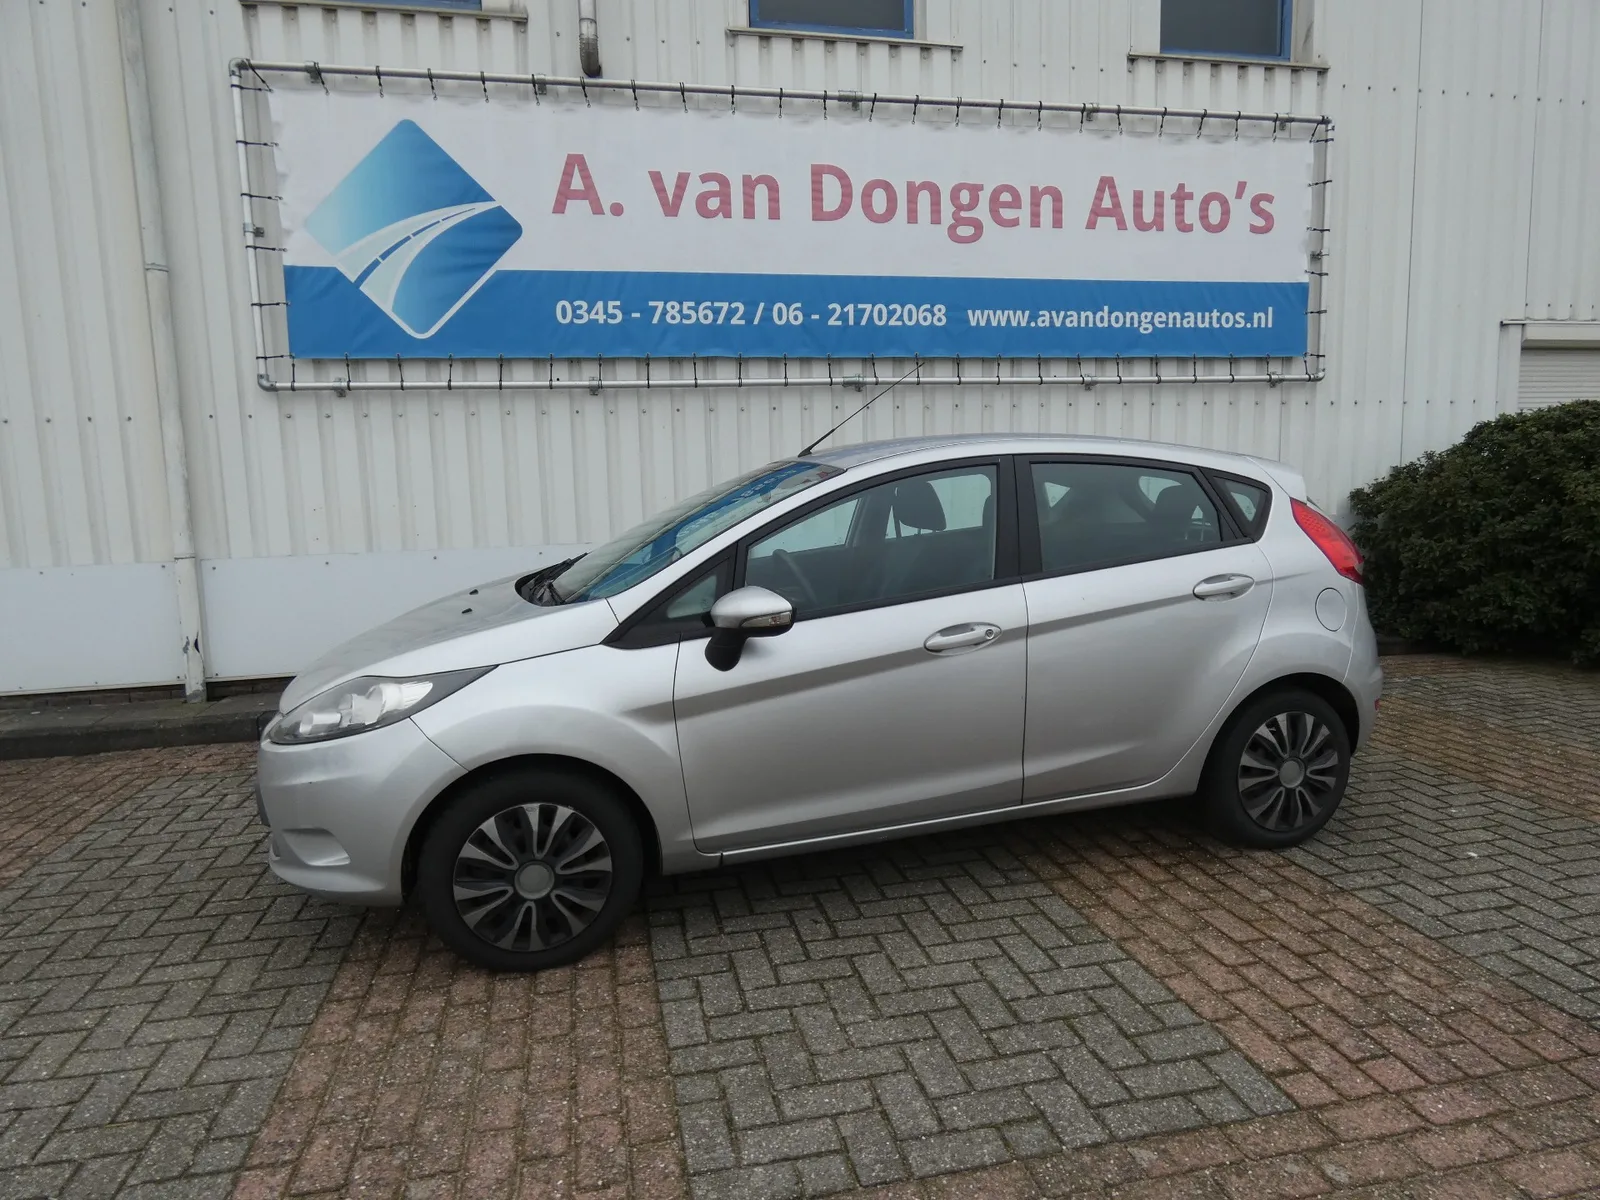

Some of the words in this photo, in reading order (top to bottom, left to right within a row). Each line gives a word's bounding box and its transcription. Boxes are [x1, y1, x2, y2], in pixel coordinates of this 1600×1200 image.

[552, 153, 624, 216] A.
[648, 170, 781, 220] van
[810, 163, 1063, 243] Dongen
[1085, 176, 1275, 234] Auto's
[555, 300, 623, 324] 0345
[648, 301, 747, 325] 785672
[772, 302, 805, 326] 06
[827, 302, 947, 327] 21702068
[967, 305, 1274, 334] www.avandongenautos.nl
